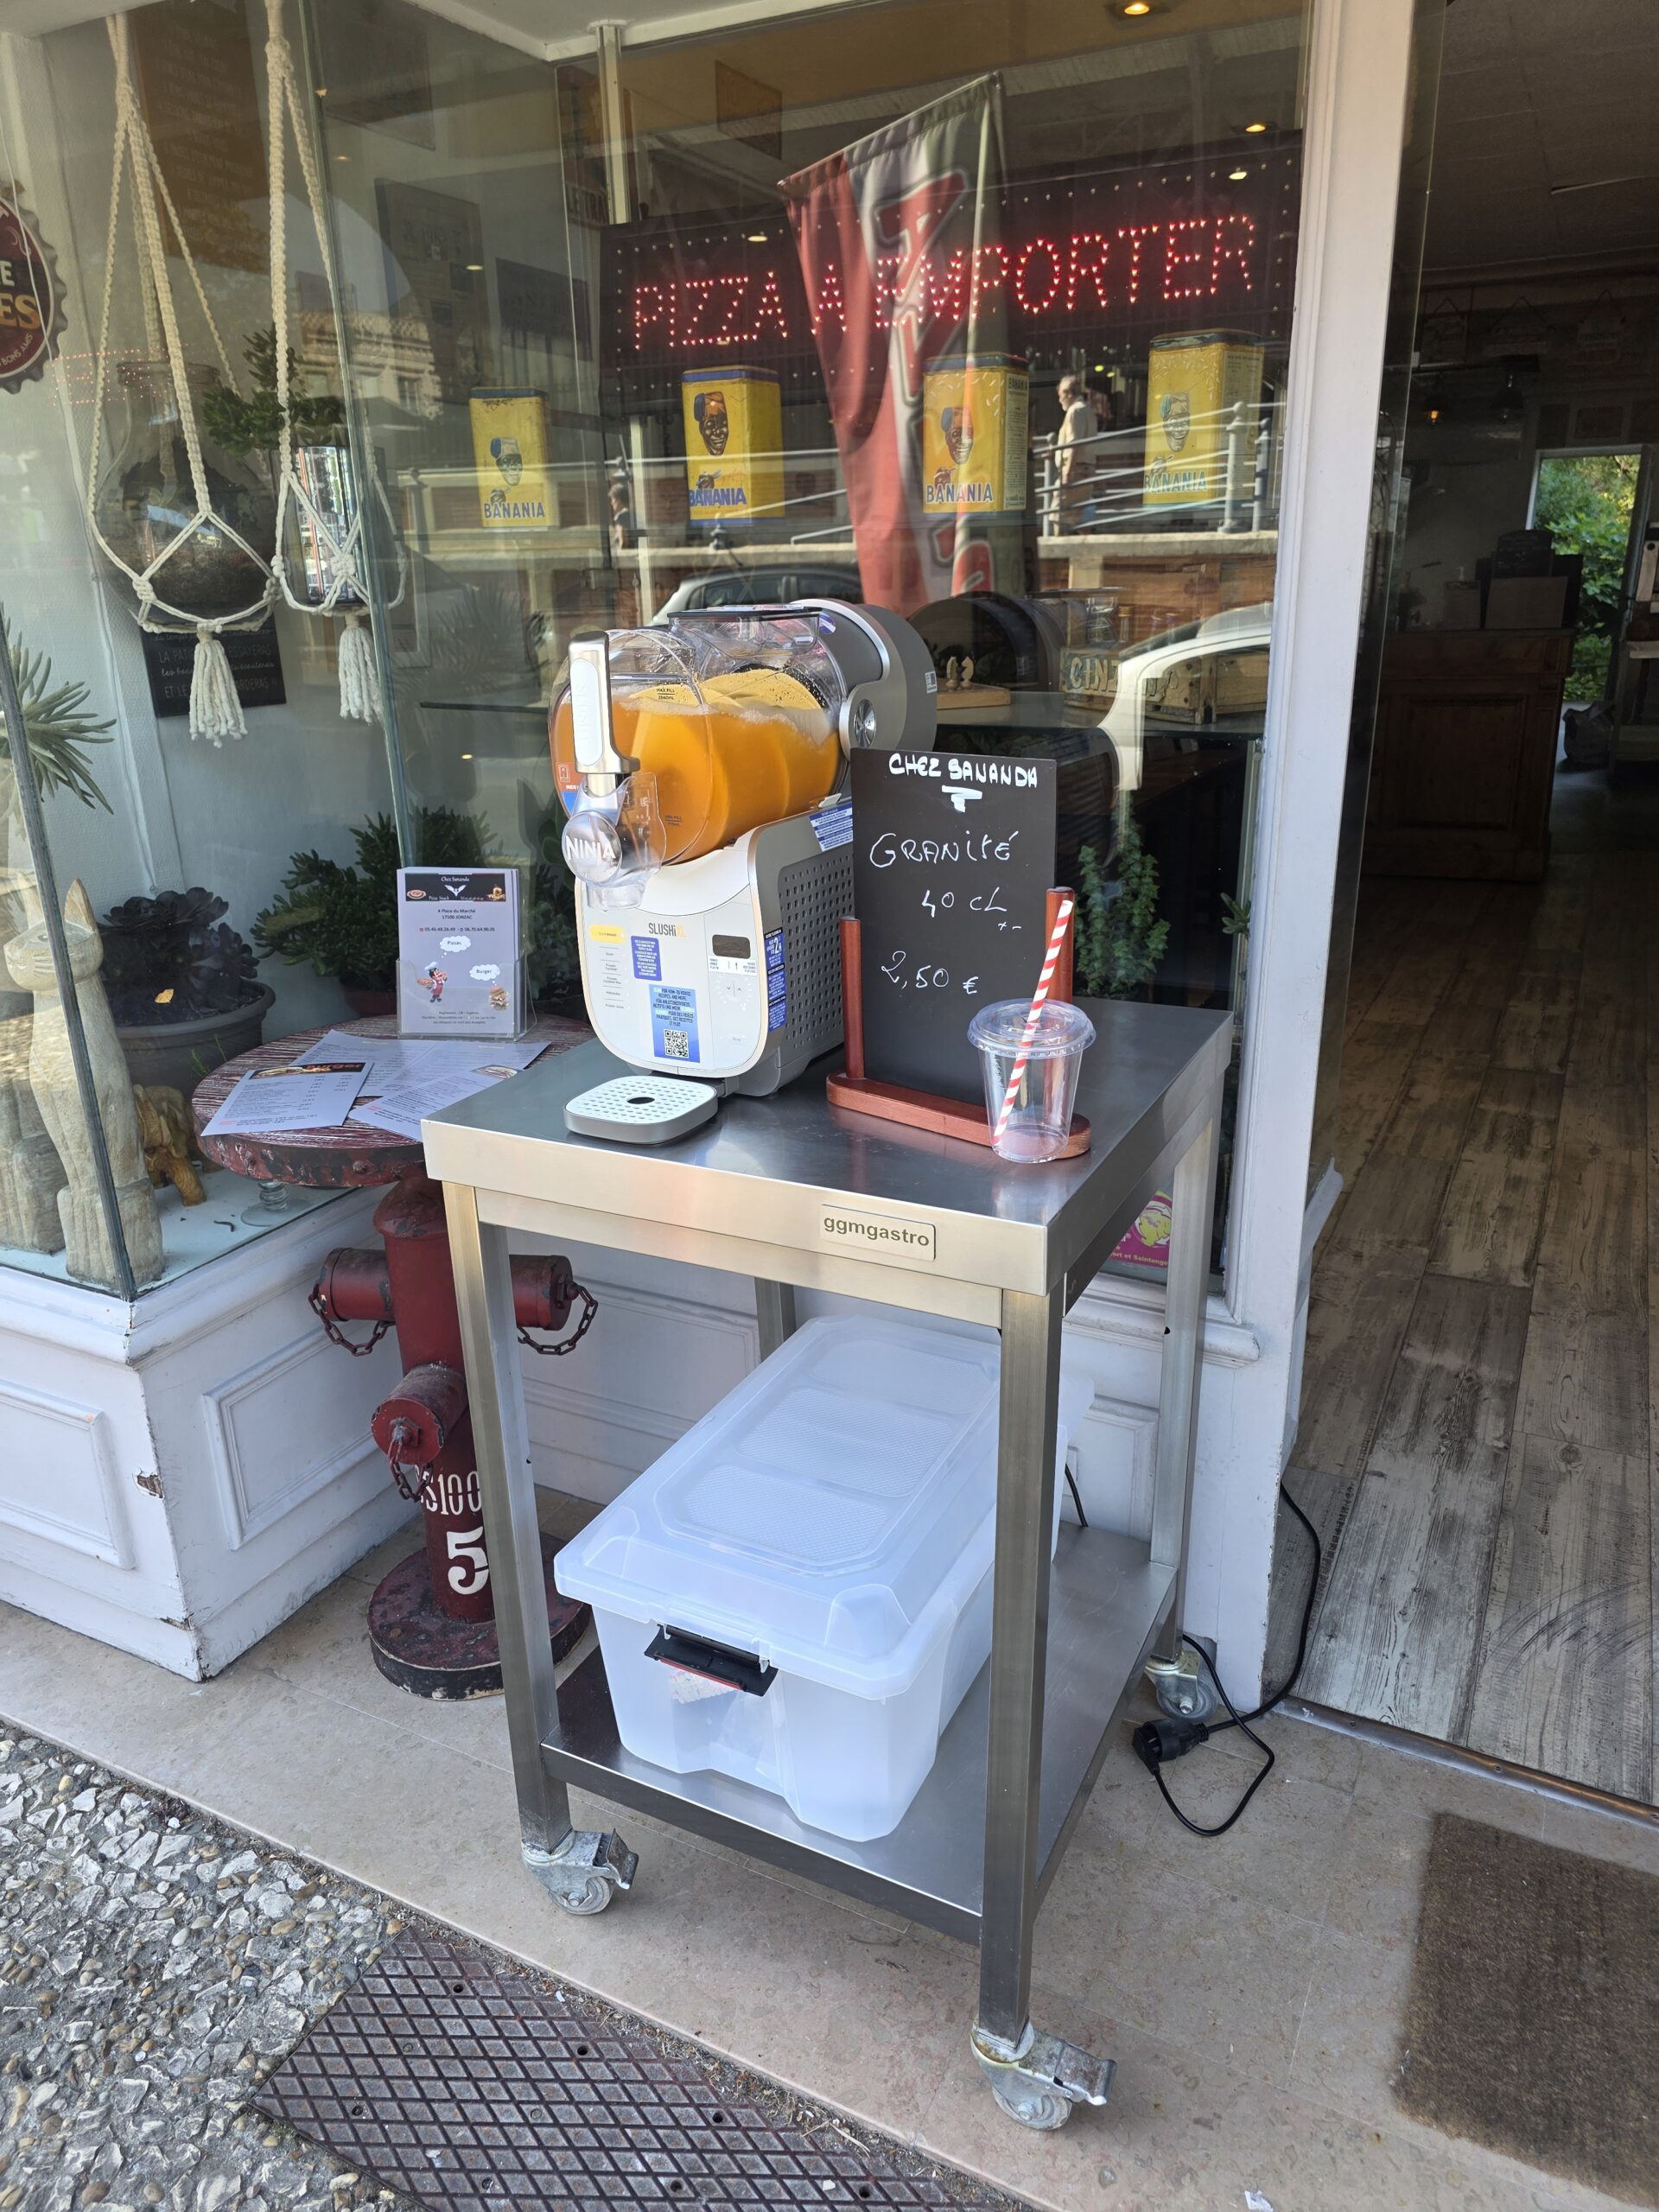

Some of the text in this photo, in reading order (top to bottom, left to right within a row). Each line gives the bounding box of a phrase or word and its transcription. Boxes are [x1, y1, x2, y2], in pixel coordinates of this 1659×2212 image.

[634, 270, 788, 350] PIZZA
[875, 214, 1255, 327] EMPORTER
[925, 482, 995, 504] BANANIA
[1143, 469, 1209, 493] BANANIA
[484, 500, 546, 519] BANANIA
[688, 486, 748, 507] BANANIA
[888, 753, 942, 778] CHEZ
[565, 835, 617, 865] NINJA
[921, 889, 955, 918] 40
[880, 950, 979, 995] 2,50 €
[823, 1217, 931, 1247] ggmgastro
[1133, 1255, 1168, 1266] Saintonge
[446, 1525, 490, 1595] 5
